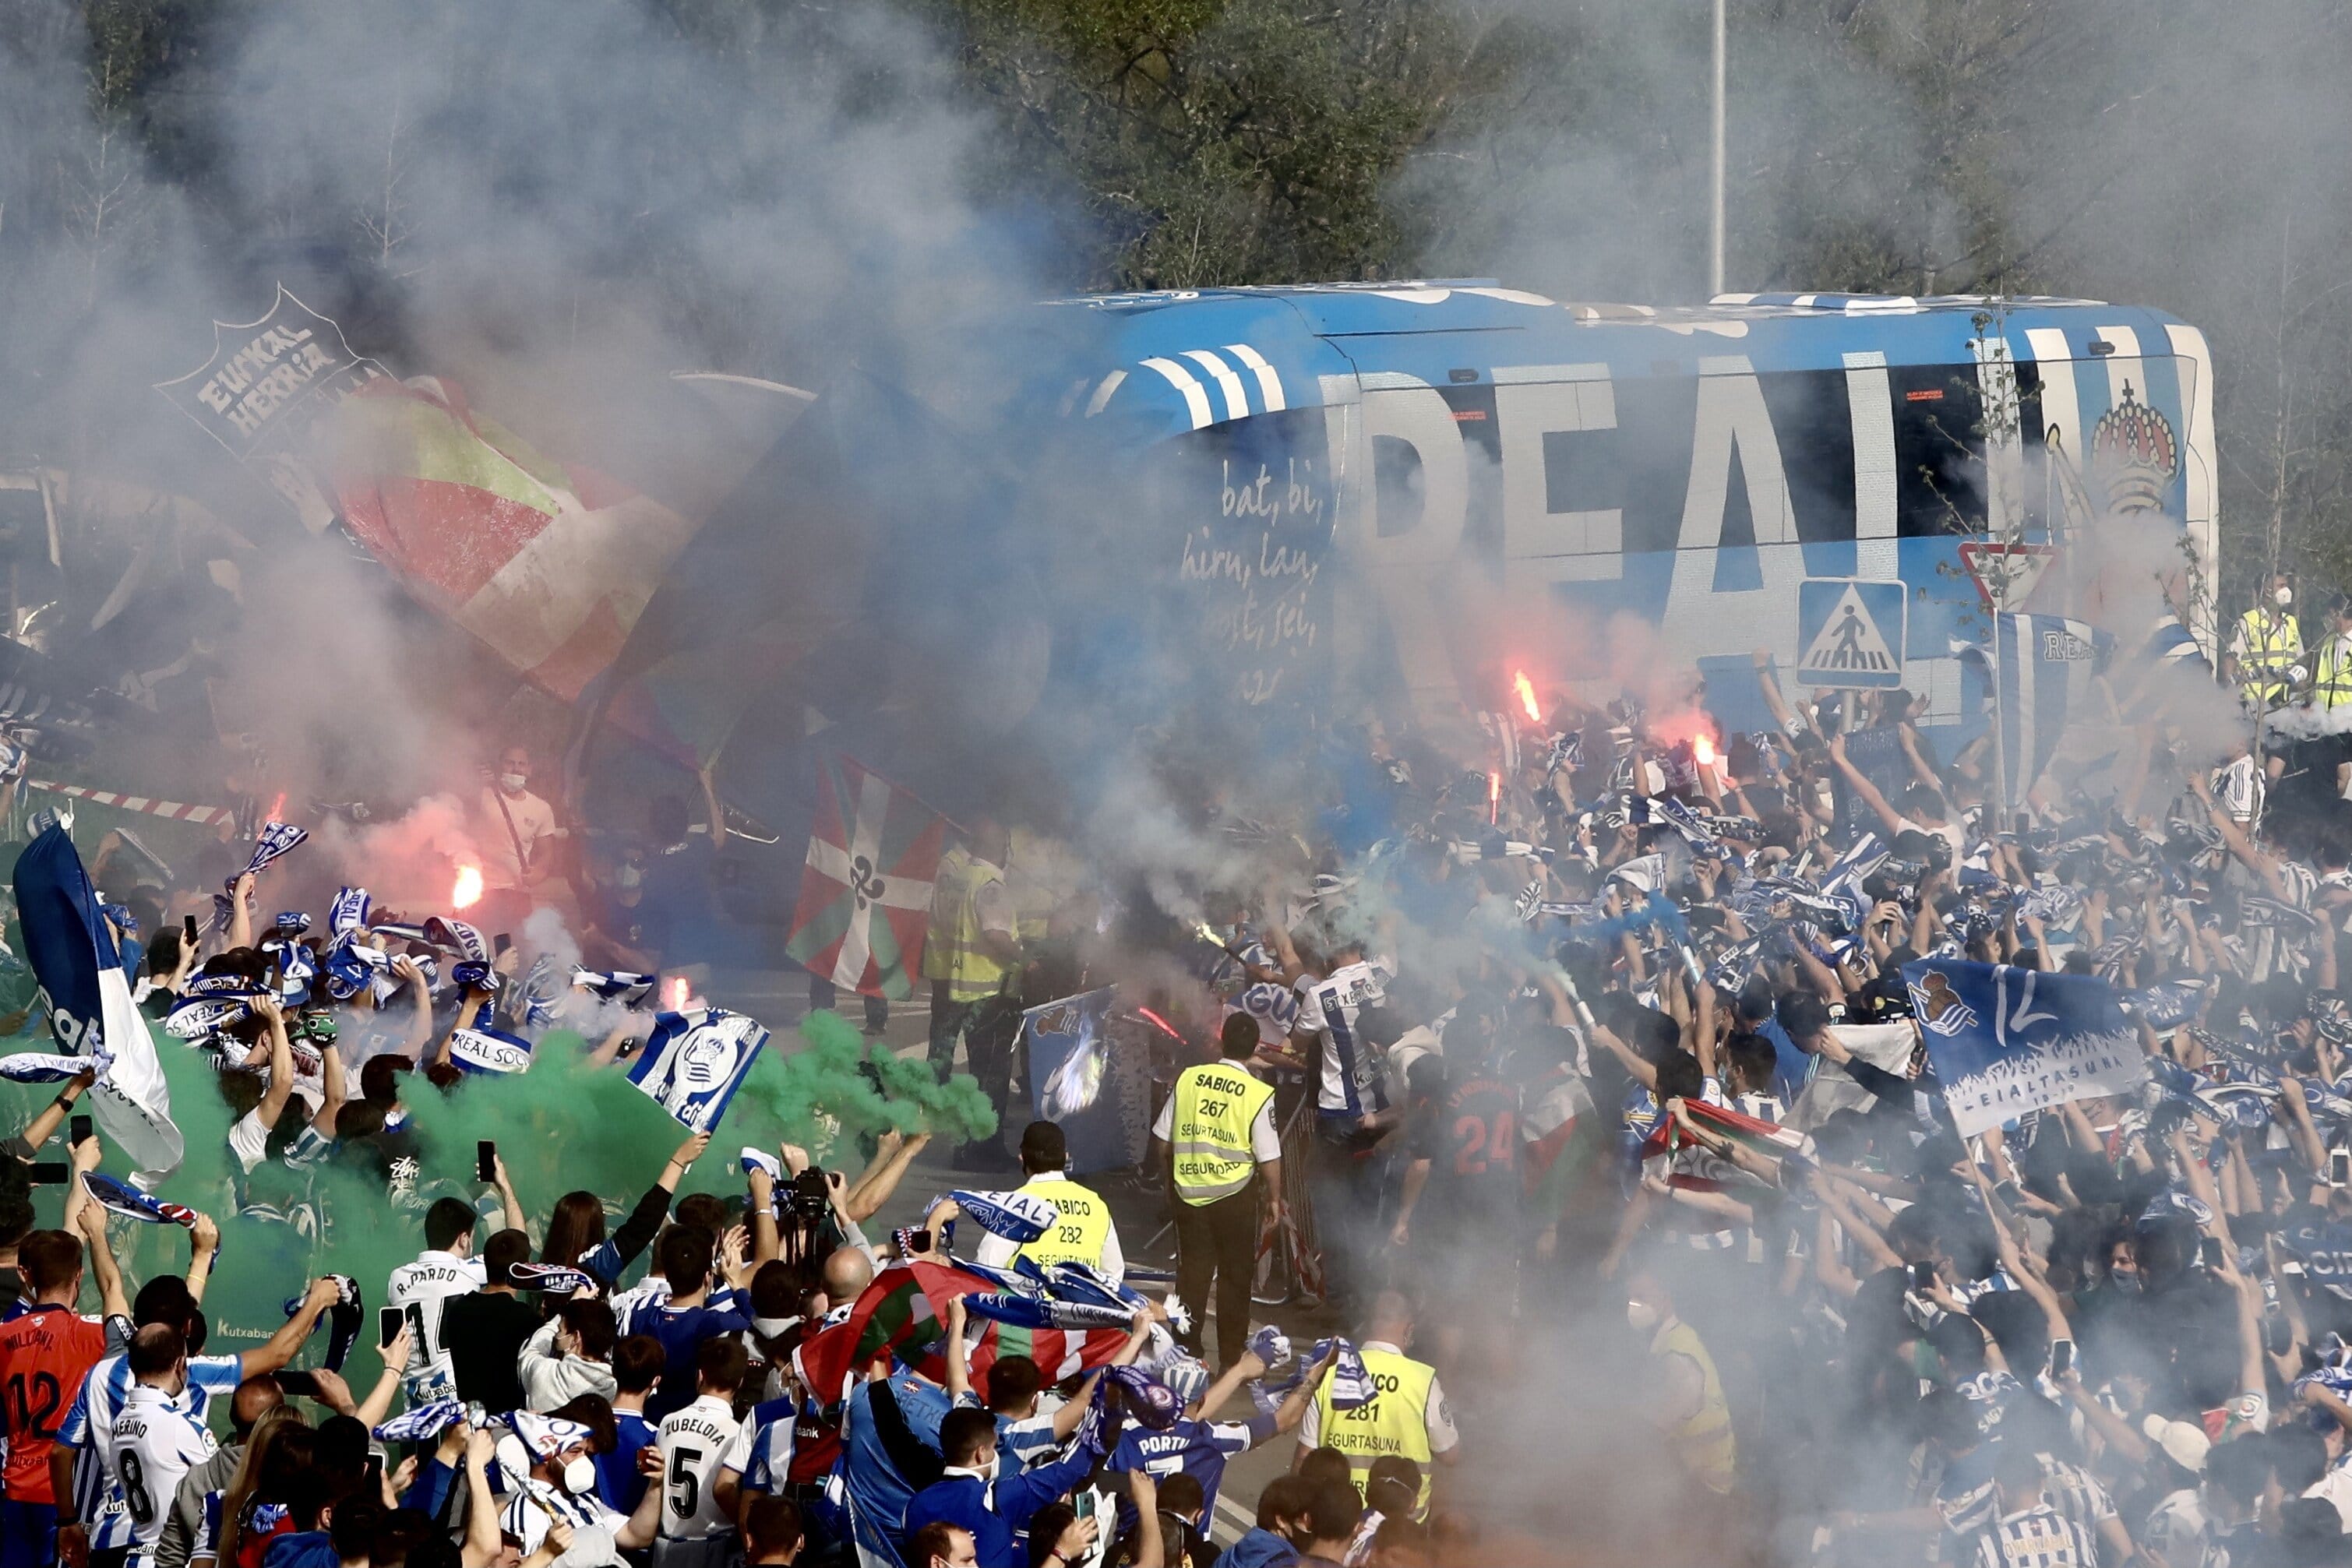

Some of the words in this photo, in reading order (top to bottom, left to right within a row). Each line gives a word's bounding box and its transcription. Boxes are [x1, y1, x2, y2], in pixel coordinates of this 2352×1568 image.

[453, 1033, 490, 1060] REAL
[1195, 1073, 1246, 1097] SABICO
[1199, 1098, 1229, 1119] 267
[1453, 1110, 1514, 1175] 24
[1058, 1225, 1082, 1245] 282
[217, 1318, 277, 1340] Kutxaban
[8, 1370, 62, 1439] 12
[111, 1419, 148, 1441] MERINO
[665, 1418, 726, 1447] ZUBELDIA
[119, 1448, 154, 1525] 8
[669, 1446, 703, 1520] 5
